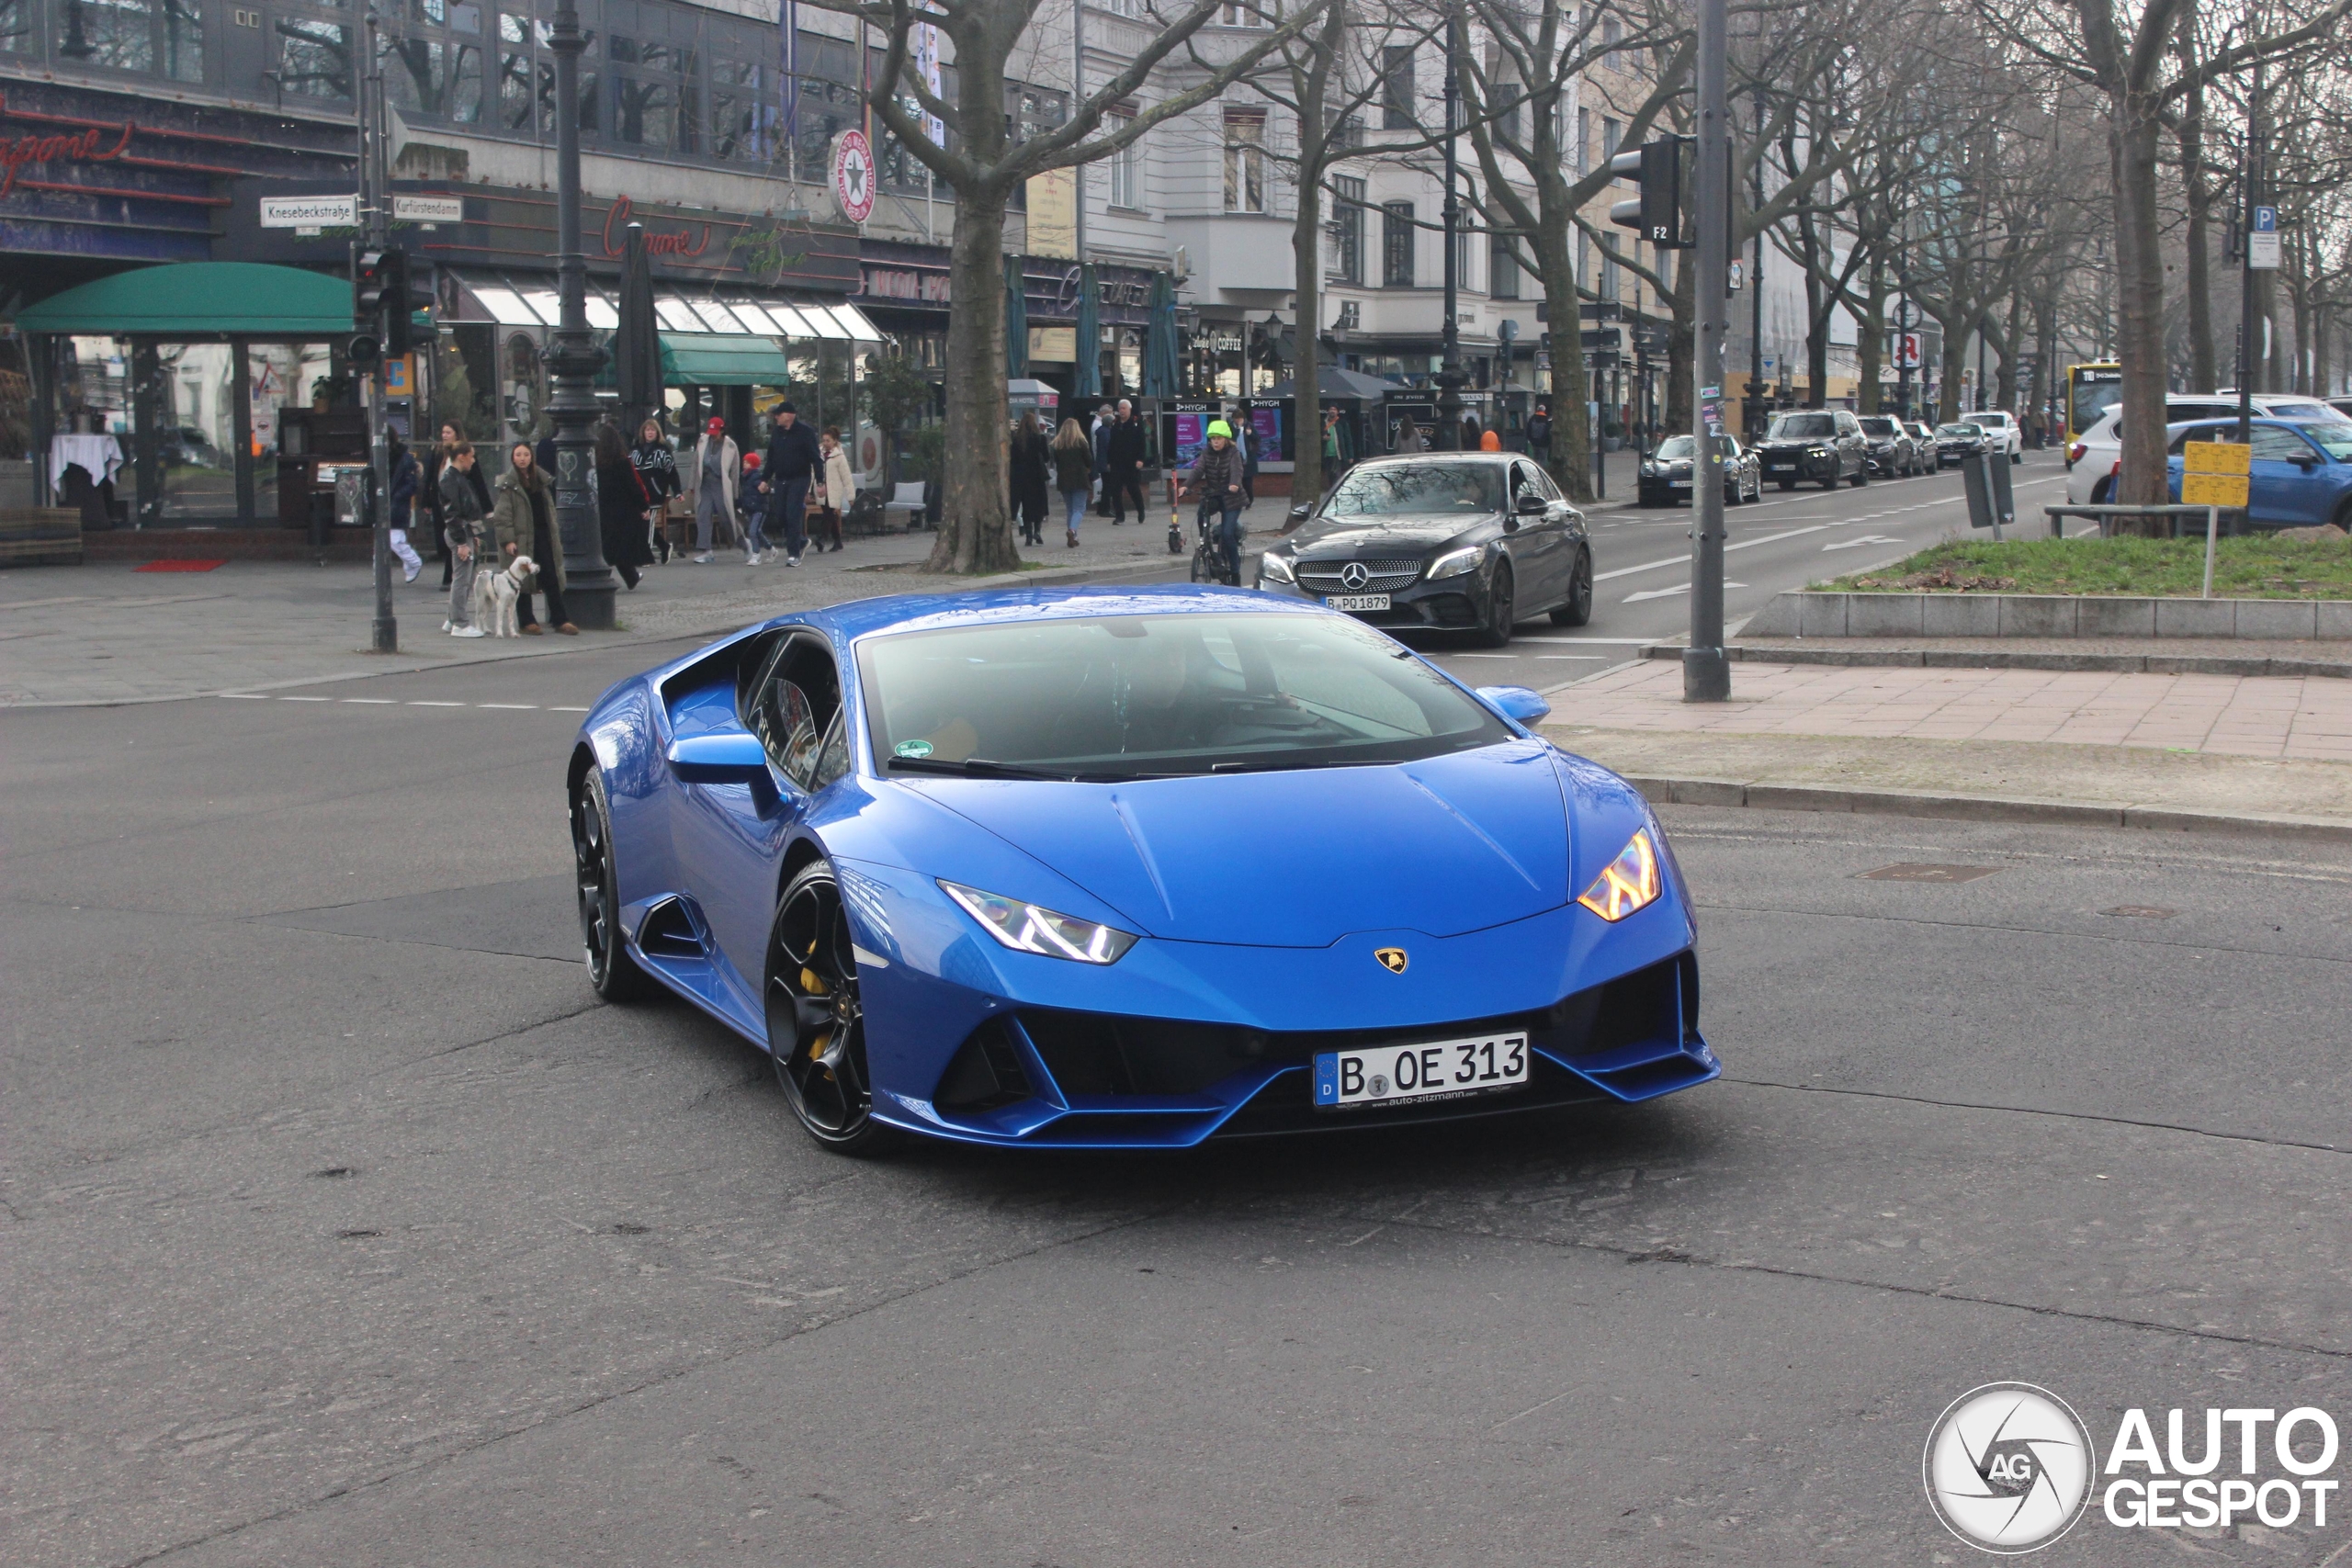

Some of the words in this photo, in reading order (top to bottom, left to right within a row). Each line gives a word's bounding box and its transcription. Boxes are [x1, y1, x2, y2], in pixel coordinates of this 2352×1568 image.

[267, 204, 351, 220] Knesebeckstraße
[395, 198, 459, 216] Kurfürstendamm
[1653, 226, 1668, 239] F2
[876, 270, 920, 299] MEDIA
[929, 276, 951, 303] HO
[1217, 337, 1242, 351] COFFEE
[1258, 400, 1280, 408] HYGH
[1342, 597, 1357, 610] PQ
[1360, 596, 1388, 609] 1879
[1340, 1056, 1365, 1097] B
[1395, 1047, 1444, 1091] OE
[1454, 1037, 1524, 1084] 313
[1322, 1084, 1332, 1096] D
[1372, 1090, 1478, 1108] www.auto-zitzmann.com
